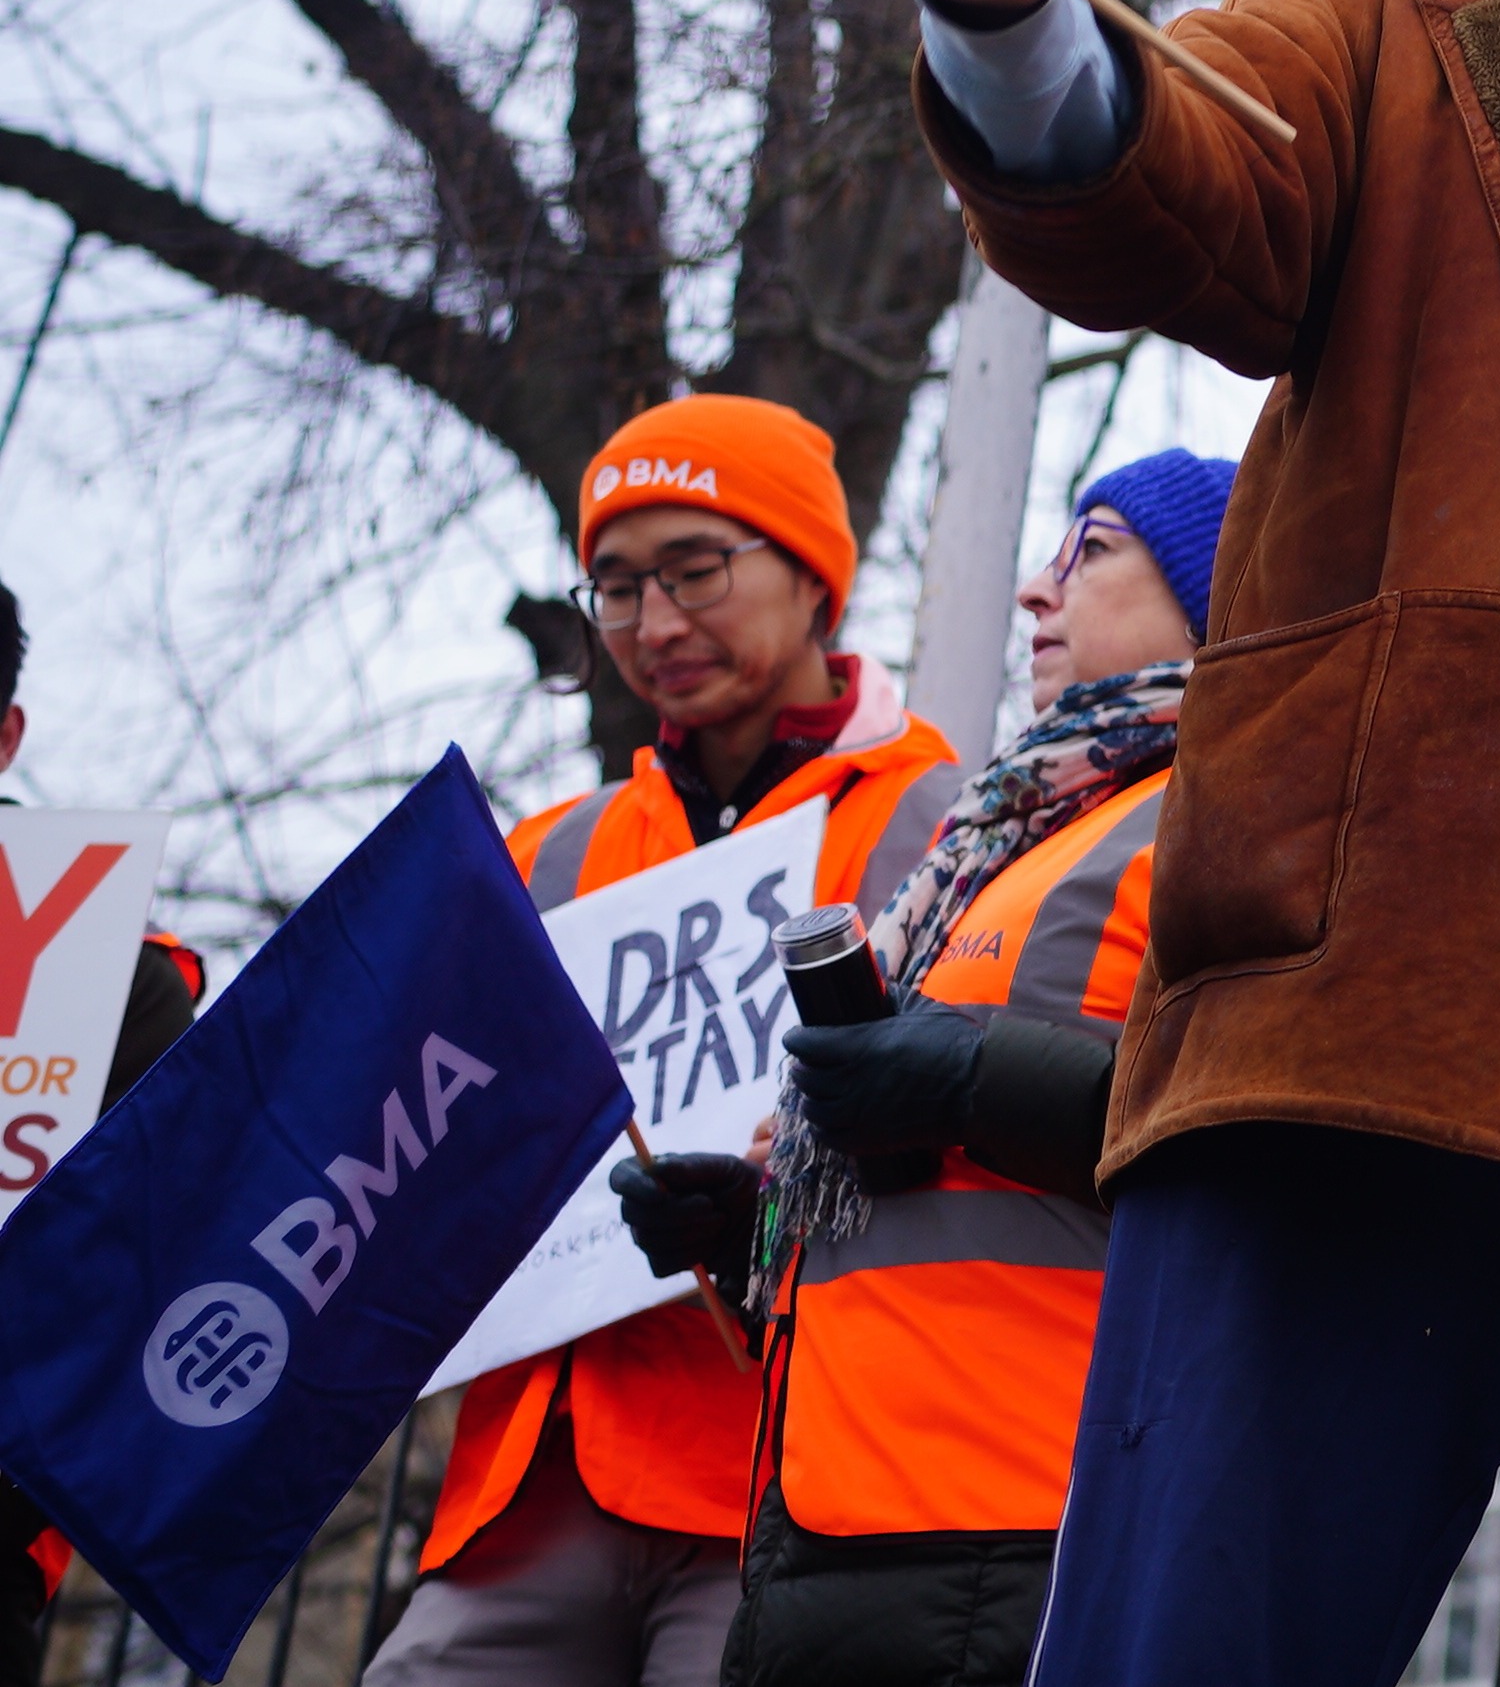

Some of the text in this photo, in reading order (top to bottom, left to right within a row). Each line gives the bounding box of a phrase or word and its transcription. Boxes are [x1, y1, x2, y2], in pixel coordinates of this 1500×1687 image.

[626, 457, 718, 499] BMA
[603, 867, 791, 1048] DRS
[614, 983, 789, 1127] TAY
[250, 1032, 498, 1316] BMA
